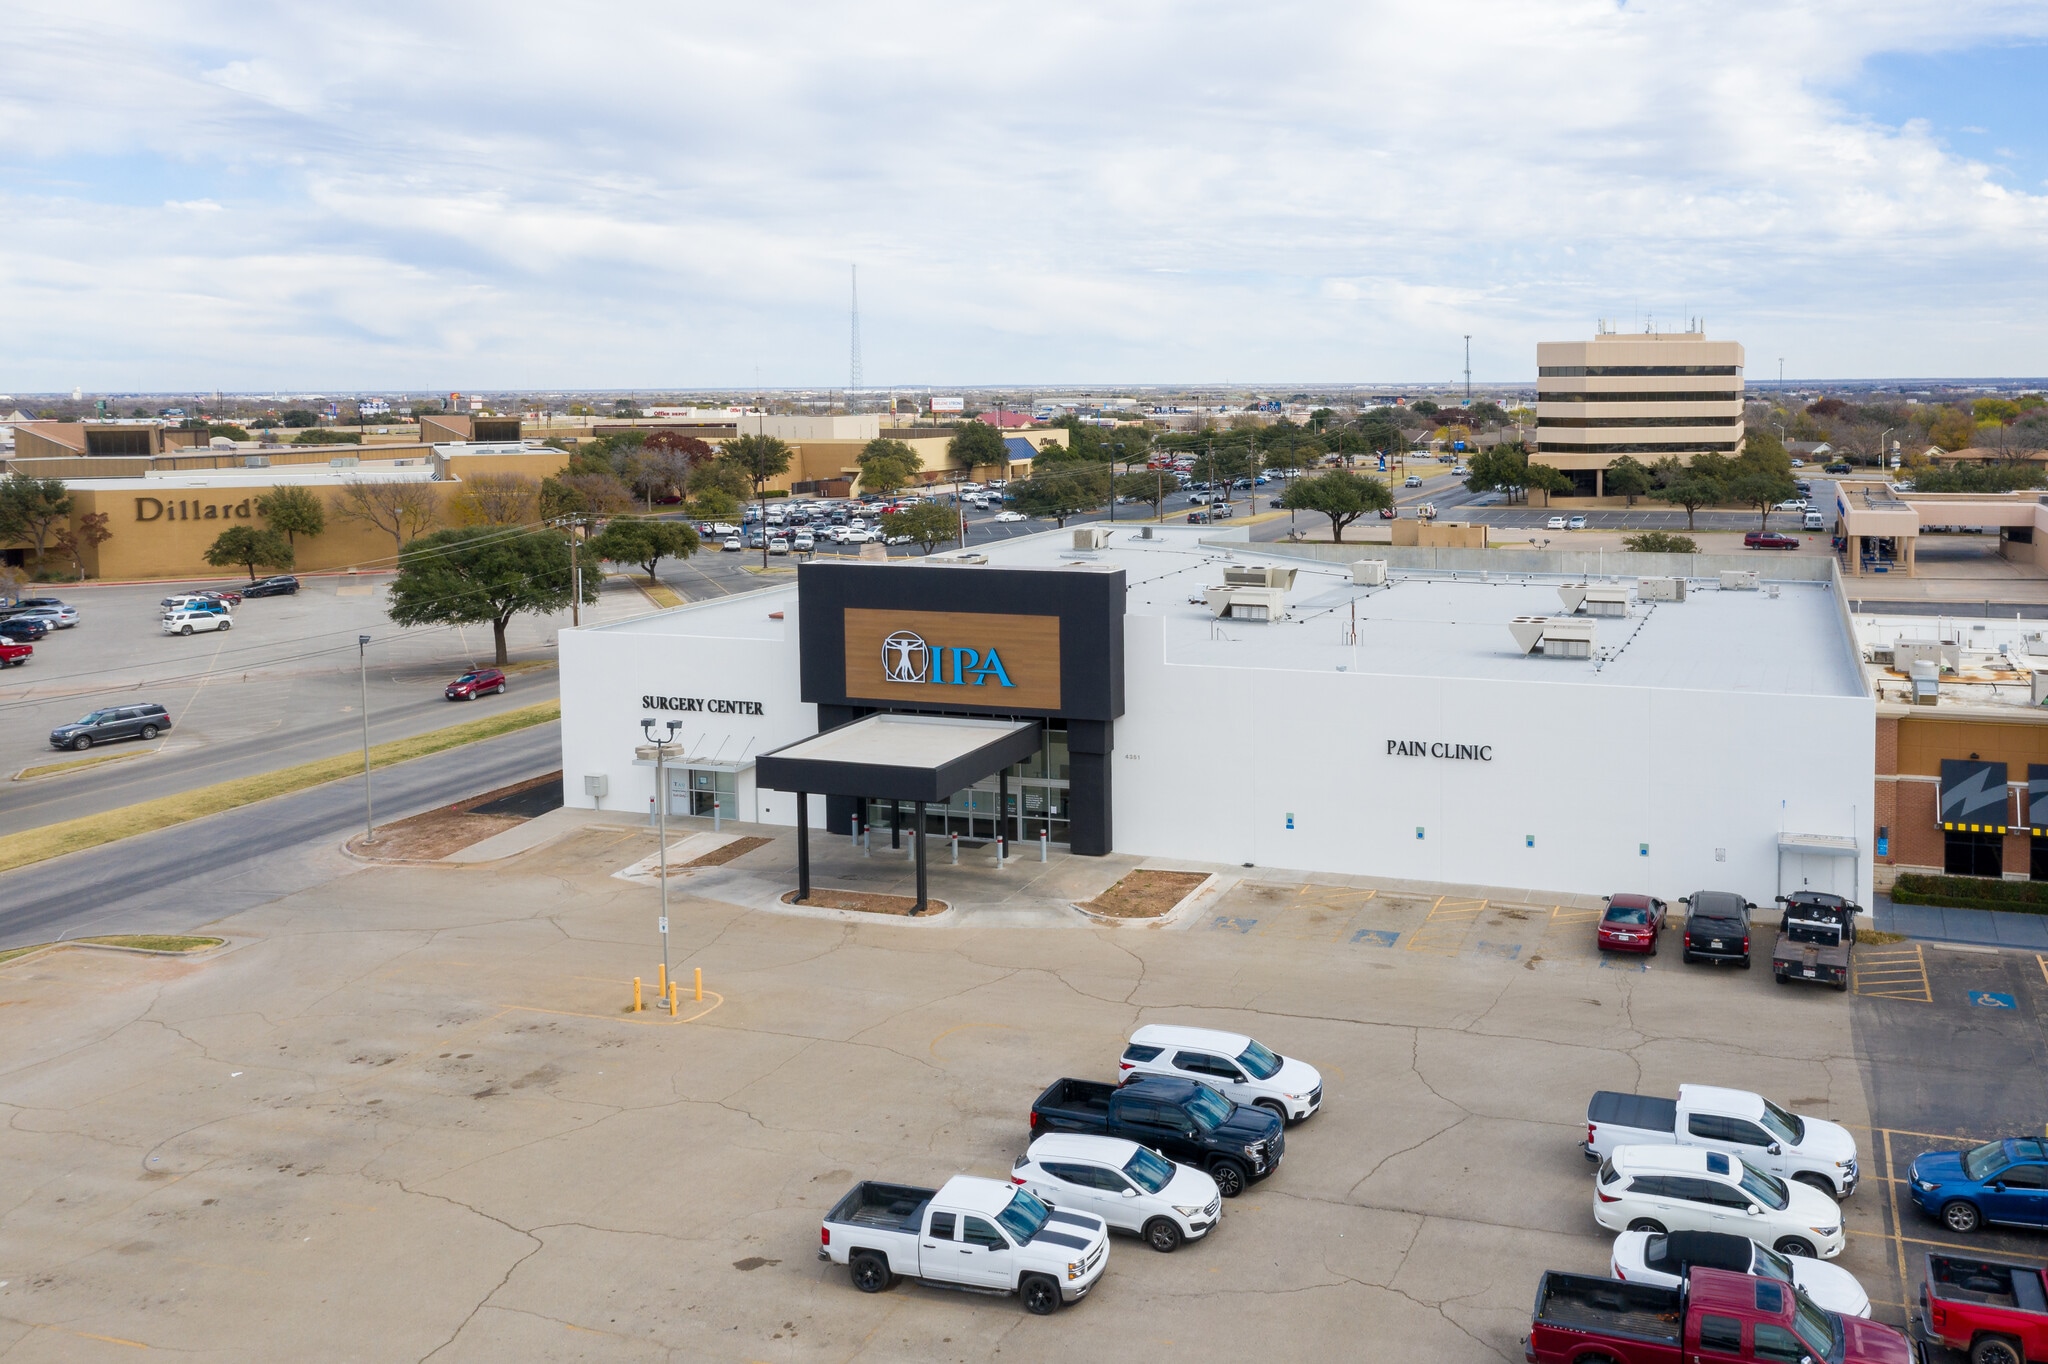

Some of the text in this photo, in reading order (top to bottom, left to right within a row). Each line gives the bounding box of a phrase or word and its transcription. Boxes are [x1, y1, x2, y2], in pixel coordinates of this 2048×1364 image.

[928, 645, 1017, 688] IPA
[642, 695, 764, 715] SURGERY CENTER
[1387, 739, 1492, 761] PAIN CLINIC
